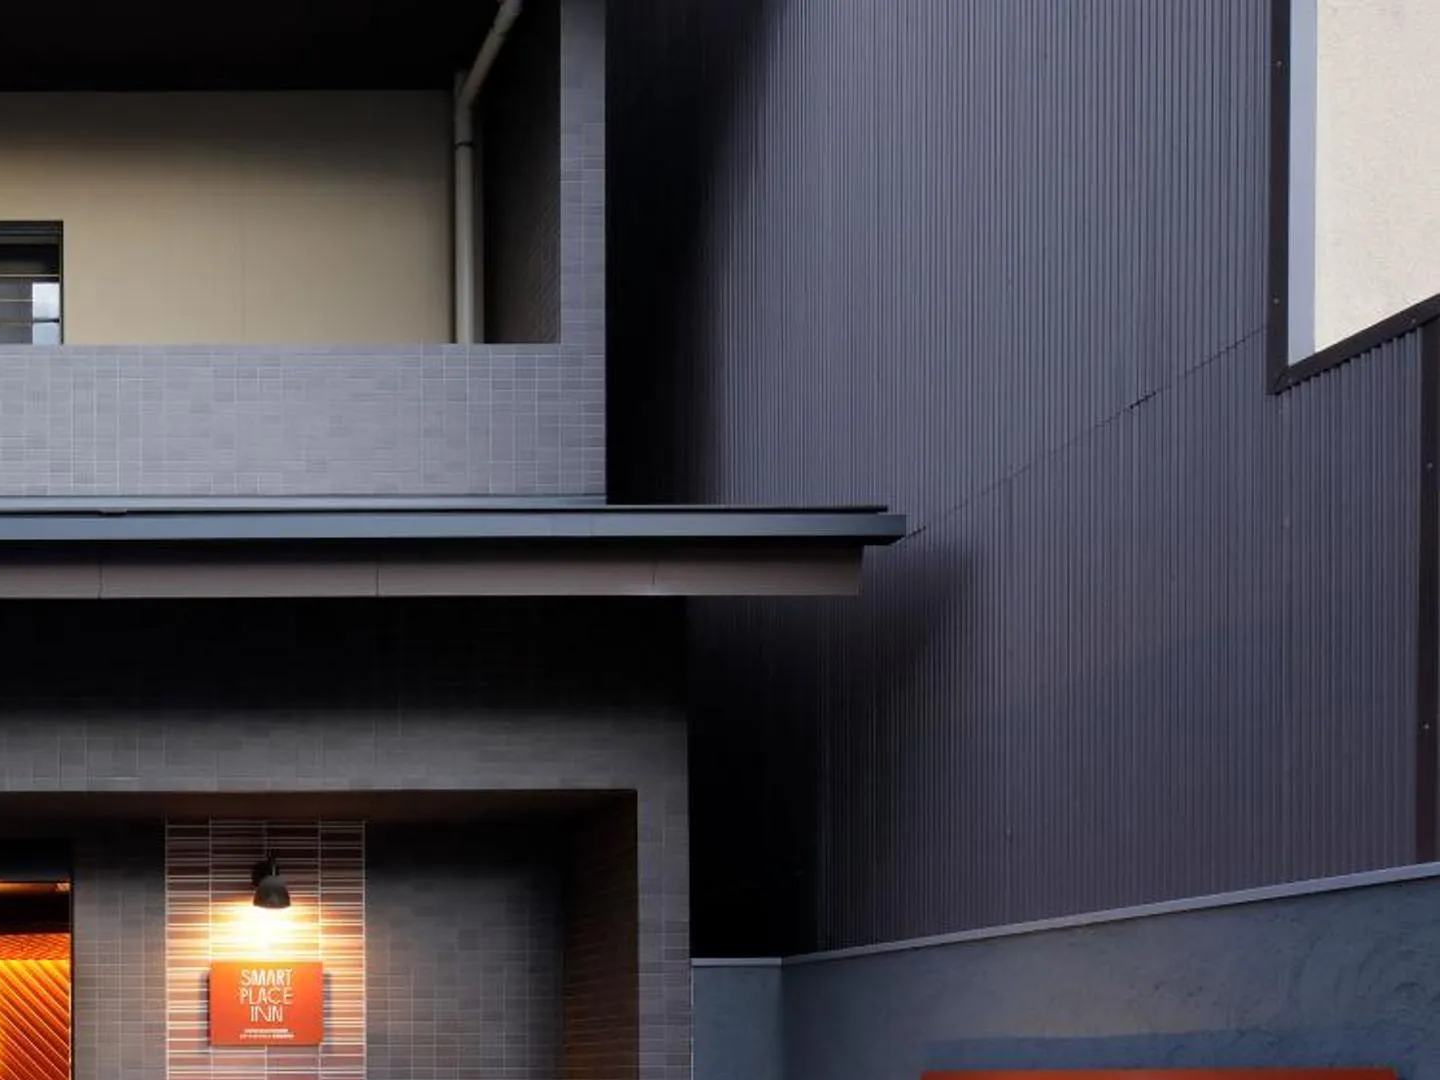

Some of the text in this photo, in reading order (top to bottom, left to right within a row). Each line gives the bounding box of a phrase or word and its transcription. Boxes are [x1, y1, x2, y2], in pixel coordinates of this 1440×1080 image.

[240, 969, 293, 986] SMART
[239, 986, 294, 1005] PLACE
[250, 1005, 284, 1022] INN
